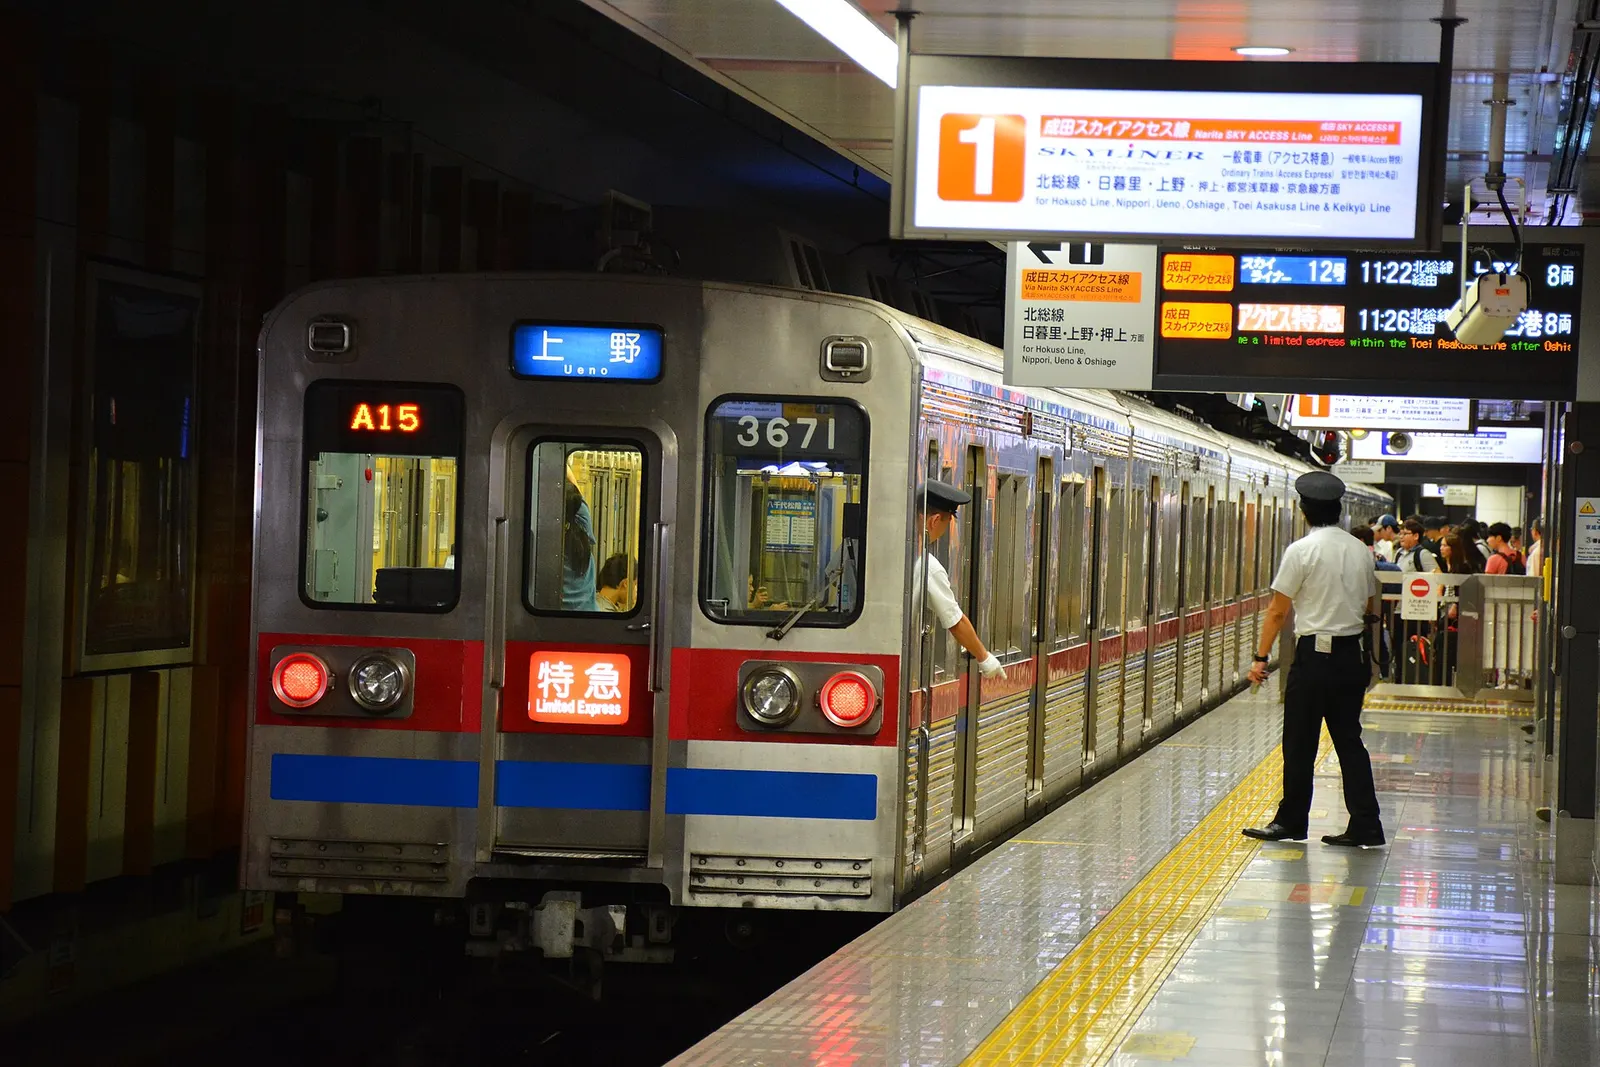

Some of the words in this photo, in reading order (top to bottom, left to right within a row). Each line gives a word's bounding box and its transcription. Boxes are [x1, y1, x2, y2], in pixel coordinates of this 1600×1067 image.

[1044, 119, 1190, 138] 成田スカイアクセス線
[1195, 131, 1223, 139] Narita
[1226, 131, 1246, 141] SKY
[1248, 131, 1289, 141] ACCESS
[1292, 132, 1313, 141] Line
[959, 117, 995, 195] 1
[1035, 197, 1049, 205] for
[1234, 201, 1253, 210] Toei
[1257, 201, 1297, 211] Asakusa
[1300, 202, 1321, 211] Line
[1323, 202, 1331, 211] &
[1370, 204, 1391, 213] Line
[1167, 261, 1192, 272] 成田
[1241, 257, 1276, 270] スカイ
[1412, 260, 1454, 275] 北総線
[1025, 271, 1130, 285] 成田スカイアクセス線
[1166, 273, 1232, 285] スカイアクセス線
[1251, 269, 1292, 283] ライナー
[1361, 261, 1412, 284] 11:22
[1412, 273, 1438, 287] 経由
[1546, 263, 1575, 287] 8両
[1024, 307, 1065, 322] 北総線
[1165, 308, 1190, 320] 成田
[1238, 304, 1344, 332] アクセス特急
[1358, 308, 1410, 332] 11:26
[1164, 321, 1230, 333] スカイアクセス線
[1409, 321, 1436, 335] 経由
[1544, 312, 1572, 336] 8両
[1023, 326, 1127, 342] 日暮里・上野・押上
[1130, 334, 1145, 343] 方面
[1023, 345, 1034, 353] for
[1252, 337, 1259, 345] a
[1264, 335, 1302, 346] limited
[1306, 337, 1345, 347] express
[1350, 337, 1385, 348] within
[1390, 339, 1407, 348] the
[1411, 338, 1432, 349] Toei
[1511, 341, 1541, 351] after
[563, 364, 608, 375] Ueno
[1055, 357, 1075, 365] Ueno
[1085, 358, 1117, 368] Oshiage
[350, 403, 419, 431] A15
[736, 415, 836, 450] 3671
[537, 660, 622, 700] 特急
[536, 698, 575, 714] Limited
[577, 699, 622, 717] Express
